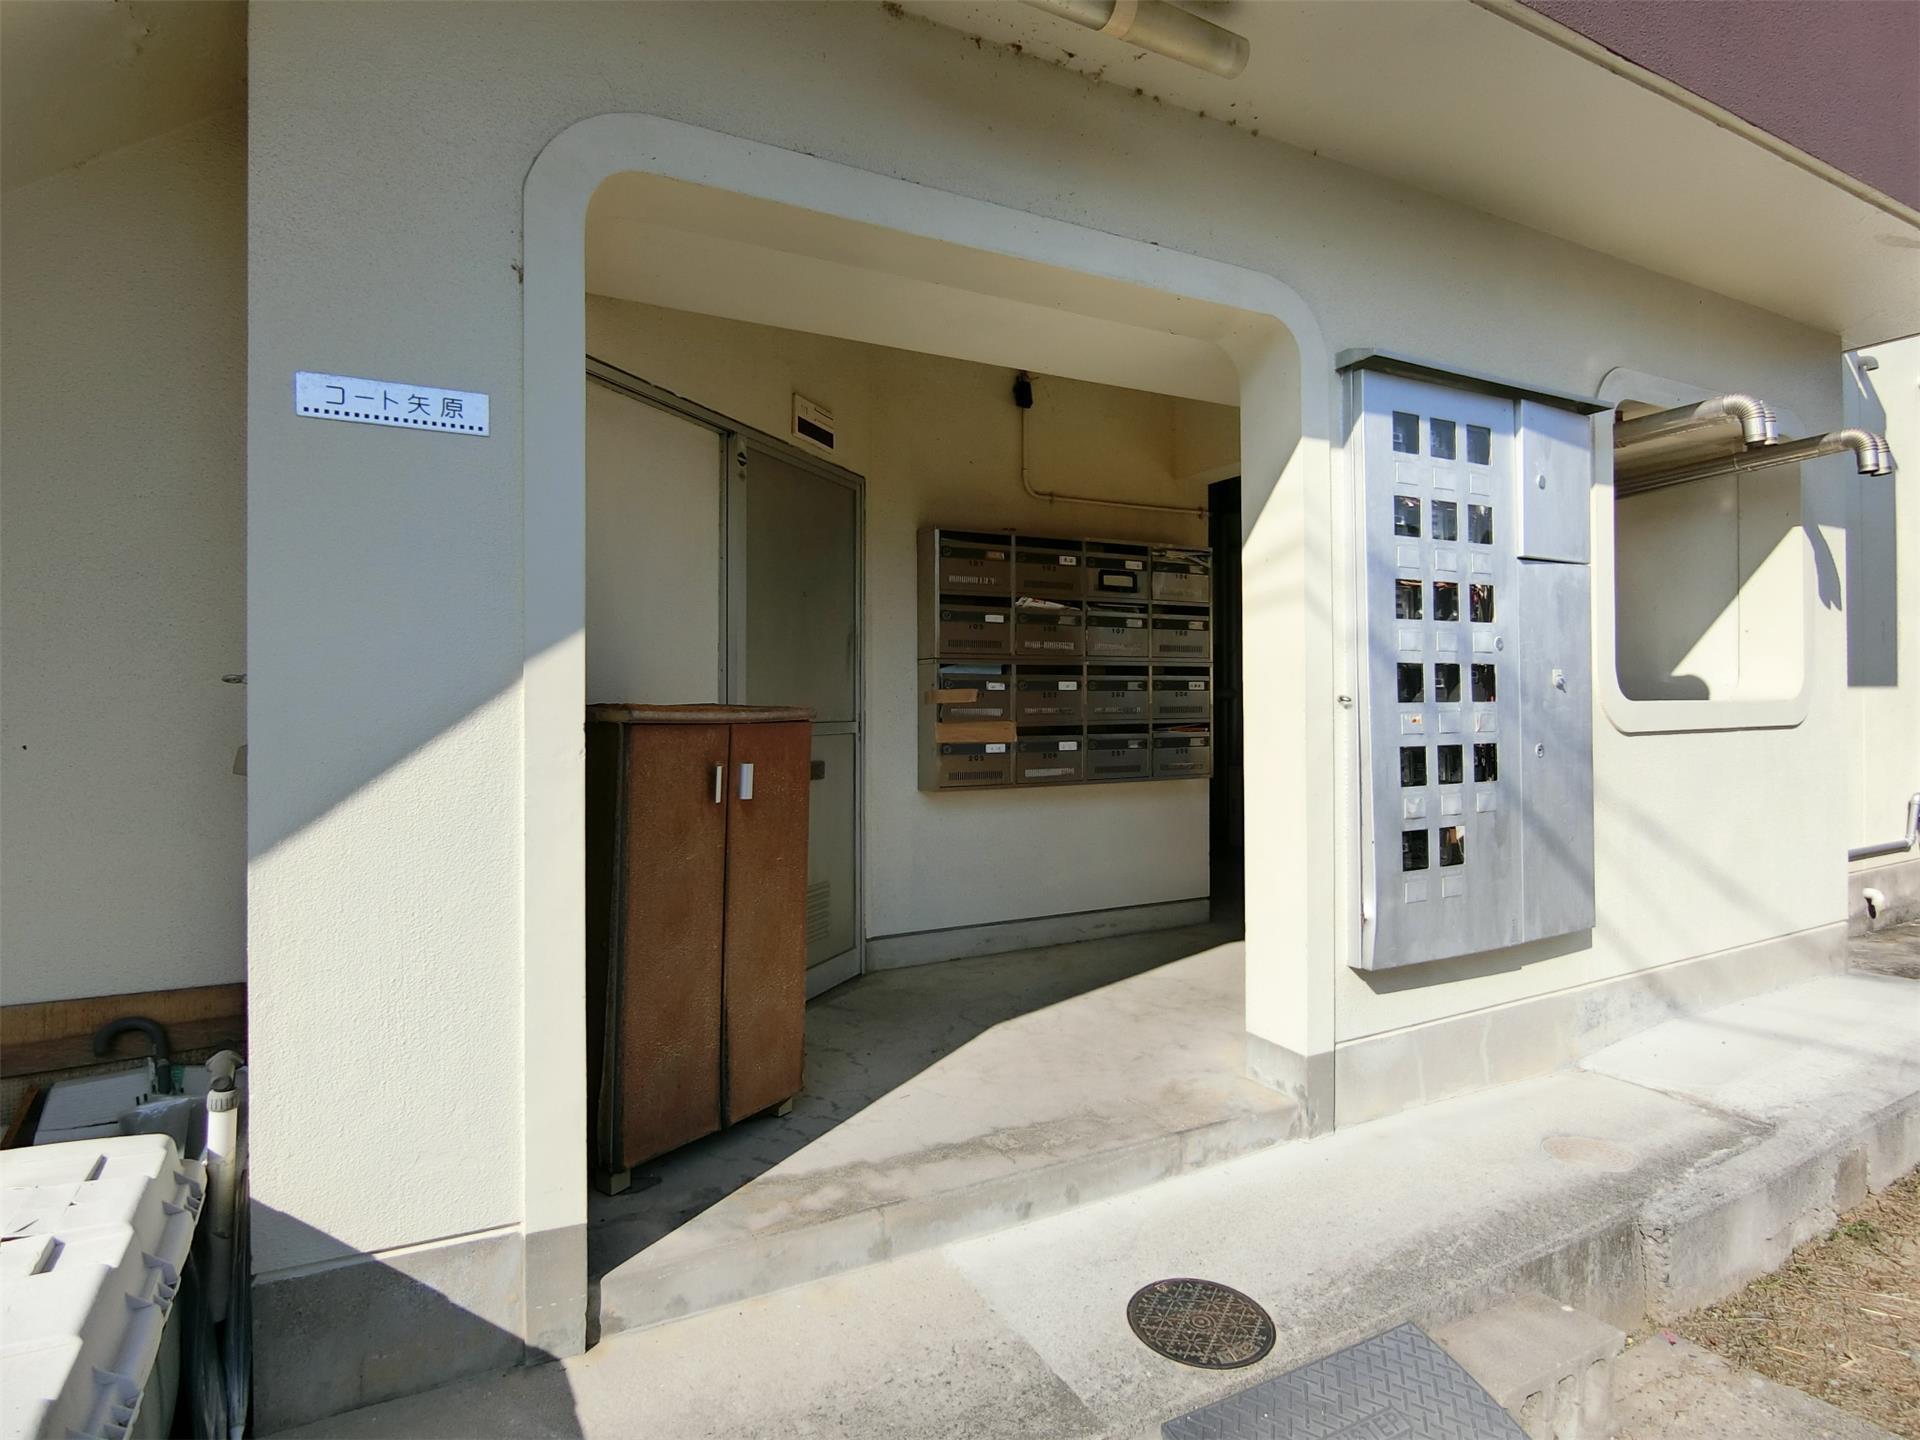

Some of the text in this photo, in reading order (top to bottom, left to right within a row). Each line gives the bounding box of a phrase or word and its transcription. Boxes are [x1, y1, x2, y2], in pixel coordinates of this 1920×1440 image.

[325, 385, 464, 419] コート矢原
[968, 559, 984, 567] 101
